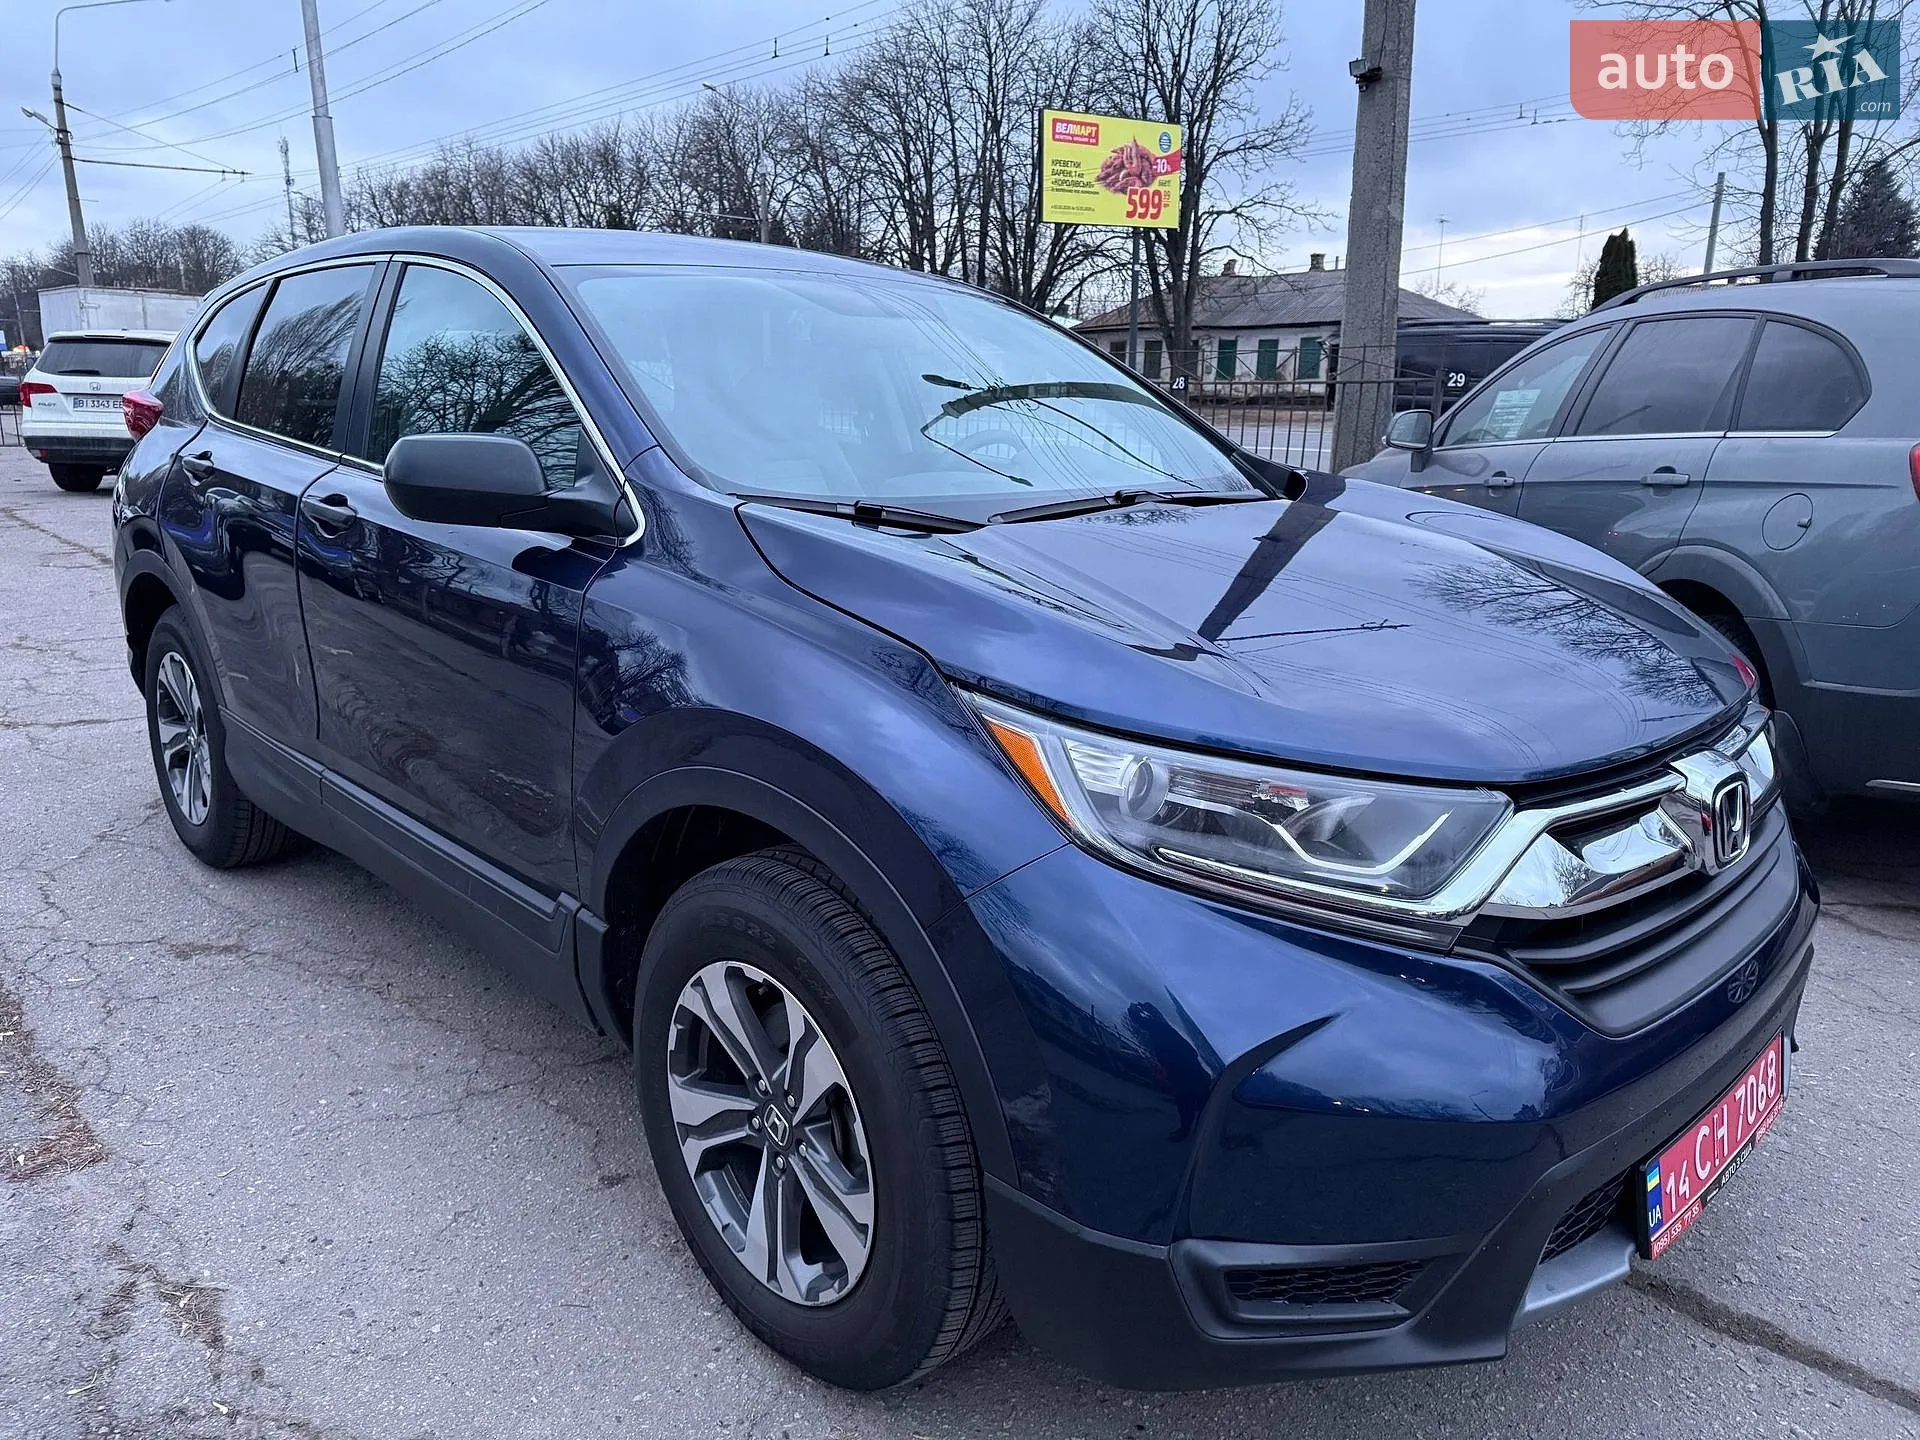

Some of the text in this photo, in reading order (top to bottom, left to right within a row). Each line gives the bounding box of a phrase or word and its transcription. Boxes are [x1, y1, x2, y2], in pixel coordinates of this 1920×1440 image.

[1055, 122, 1097, 138] ВЕЛМАРТ
[1126, 188, 1162, 219] 599
[1171, 376, 1185, 389] 28
[1447, 372, 1465, 387] 29
[79, 400, 89, 408] BI
[90, 400, 110, 408] 3343
[1666, 1159, 1690, 1213] 14
[1695, 1104, 1729, 1180] CH
[1735, 1050, 1776, 1142] 7068
[1721, 1163, 1736, 1187] АВТО
[1649, 1205, 1661, 1227] UA
